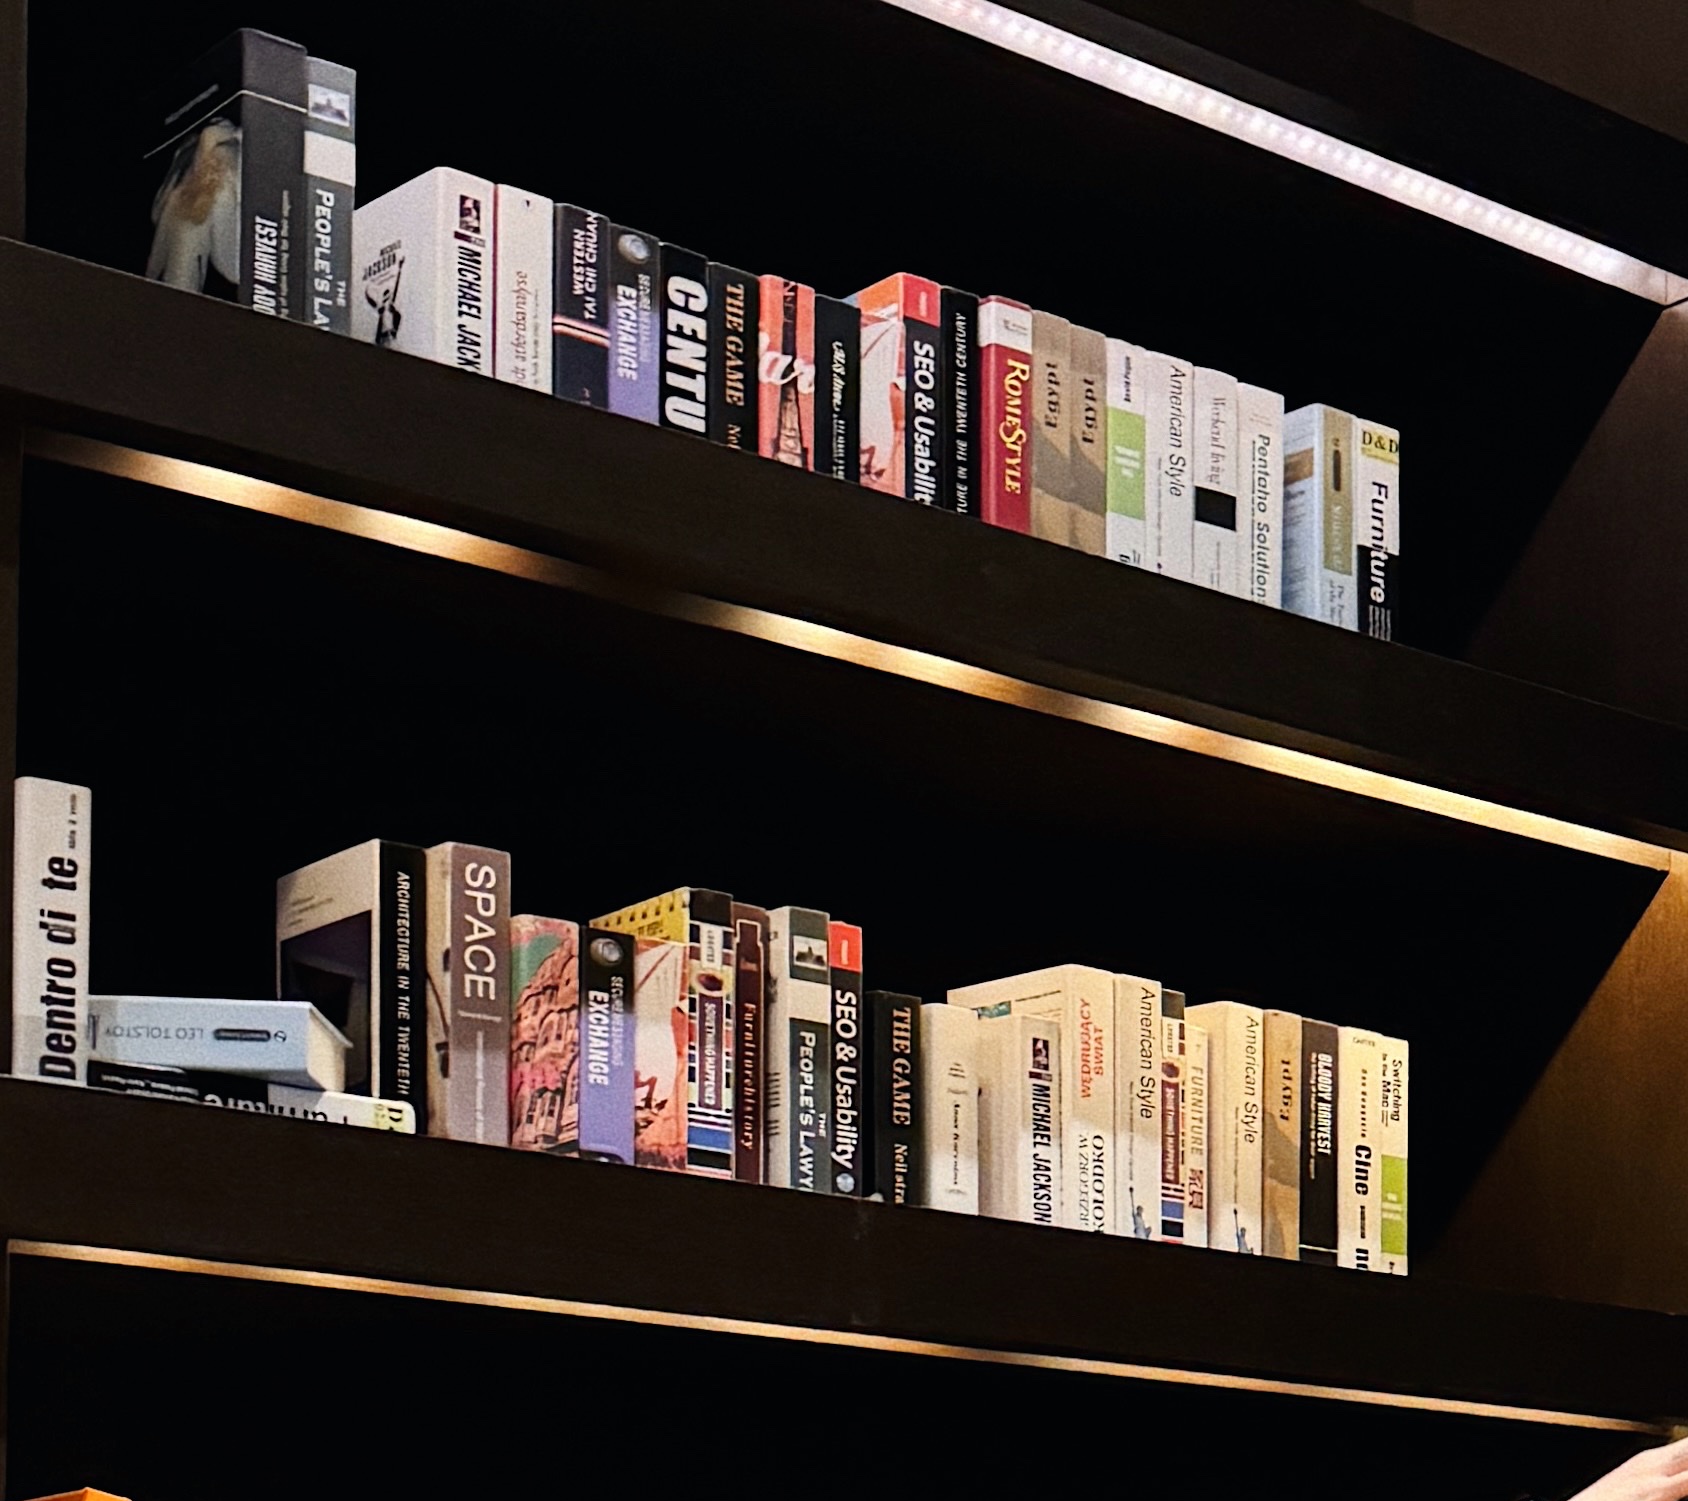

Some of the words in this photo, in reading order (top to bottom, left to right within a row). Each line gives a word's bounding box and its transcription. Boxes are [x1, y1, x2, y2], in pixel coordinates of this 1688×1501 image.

[254, 215, 279, 283] HARVEST
[314, 188, 335, 294] PEOPLE'S
[572, 229, 585, 296] WESTERN
[583, 212, 600, 265] CHUAN
[336, 280, 346, 307] THE
[457, 245, 483, 320] MICHAEL
[583, 268, 597, 298] CHI
[583, 300, 597, 320] TAI
[726, 282, 744, 333] THE
[313, 297, 330, 332] LA
[617, 284, 638, 381] EXCHANGE
[955, 312, 968, 369] CENTURY
[665, 275, 709, 433] CENTU
[726, 334, 745, 407] GAME
[913, 340, 935, 391] SEO
[914, 394, 935, 416] &
[1045, 362, 1061, 429] Egypt
[1082, 378, 1098, 444] Egypt
[1168, 365, 1187, 448] American
[955, 439, 968, 462] THE
[955, 465, 968, 481] IN
[1169, 453, 1187, 498] Style
[1257, 433, 1271, 513] Pentaho
[1370, 480, 1389, 604] Furniture
[41, 854, 79, 891] te
[39, 907, 77, 945] di
[397, 870, 411, 971] ARCHITECTURE
[463, 862, 497, 1001] SPACE
[397, 974, 411, 990] IN
[397, 993, 411, 1020] THE
[39, 956, 77, 1080] Dentro
[103, 1024, 172, 1040] TOLSTOY
[175, 1026, 205, 1041] LEO
[588, 990, 610, 1087] EXCHANGE
[835, 990, 858, 1040] SEO
[893, 1006, 912, 1055] THE
[1139, 986, 1157, 1071] American
[797, 1030, 817, 1127] PEOPLE'S
[836, 1042, 858, 1063] &
[1244, 1015, 1260, 1098] American
[1317, 1052, 1333, 1102] BLOODY
[830, 1065, 859, 1170] Usability
[893, 1057, 912, 1127] GAME
[1031, 1082, 1052, 1150] MICHAEL
[1140, 1077, 1157, 1120] Style
[1190, 1065, 1204, 1157] FURNITURE
[1381, 1079, 1392, 1108] Mac
[1390, 1058, 1402, 1123] Switching
[817, 1112, 828, 1138] THE
[1240, 1099, 1260, 1145] Style
[1316, 1102, 1332, 1157] HARVEST
[1032, 1151, 1054, 1225] JACKSON
[1355, 1144, 1372, 1196] Cine
